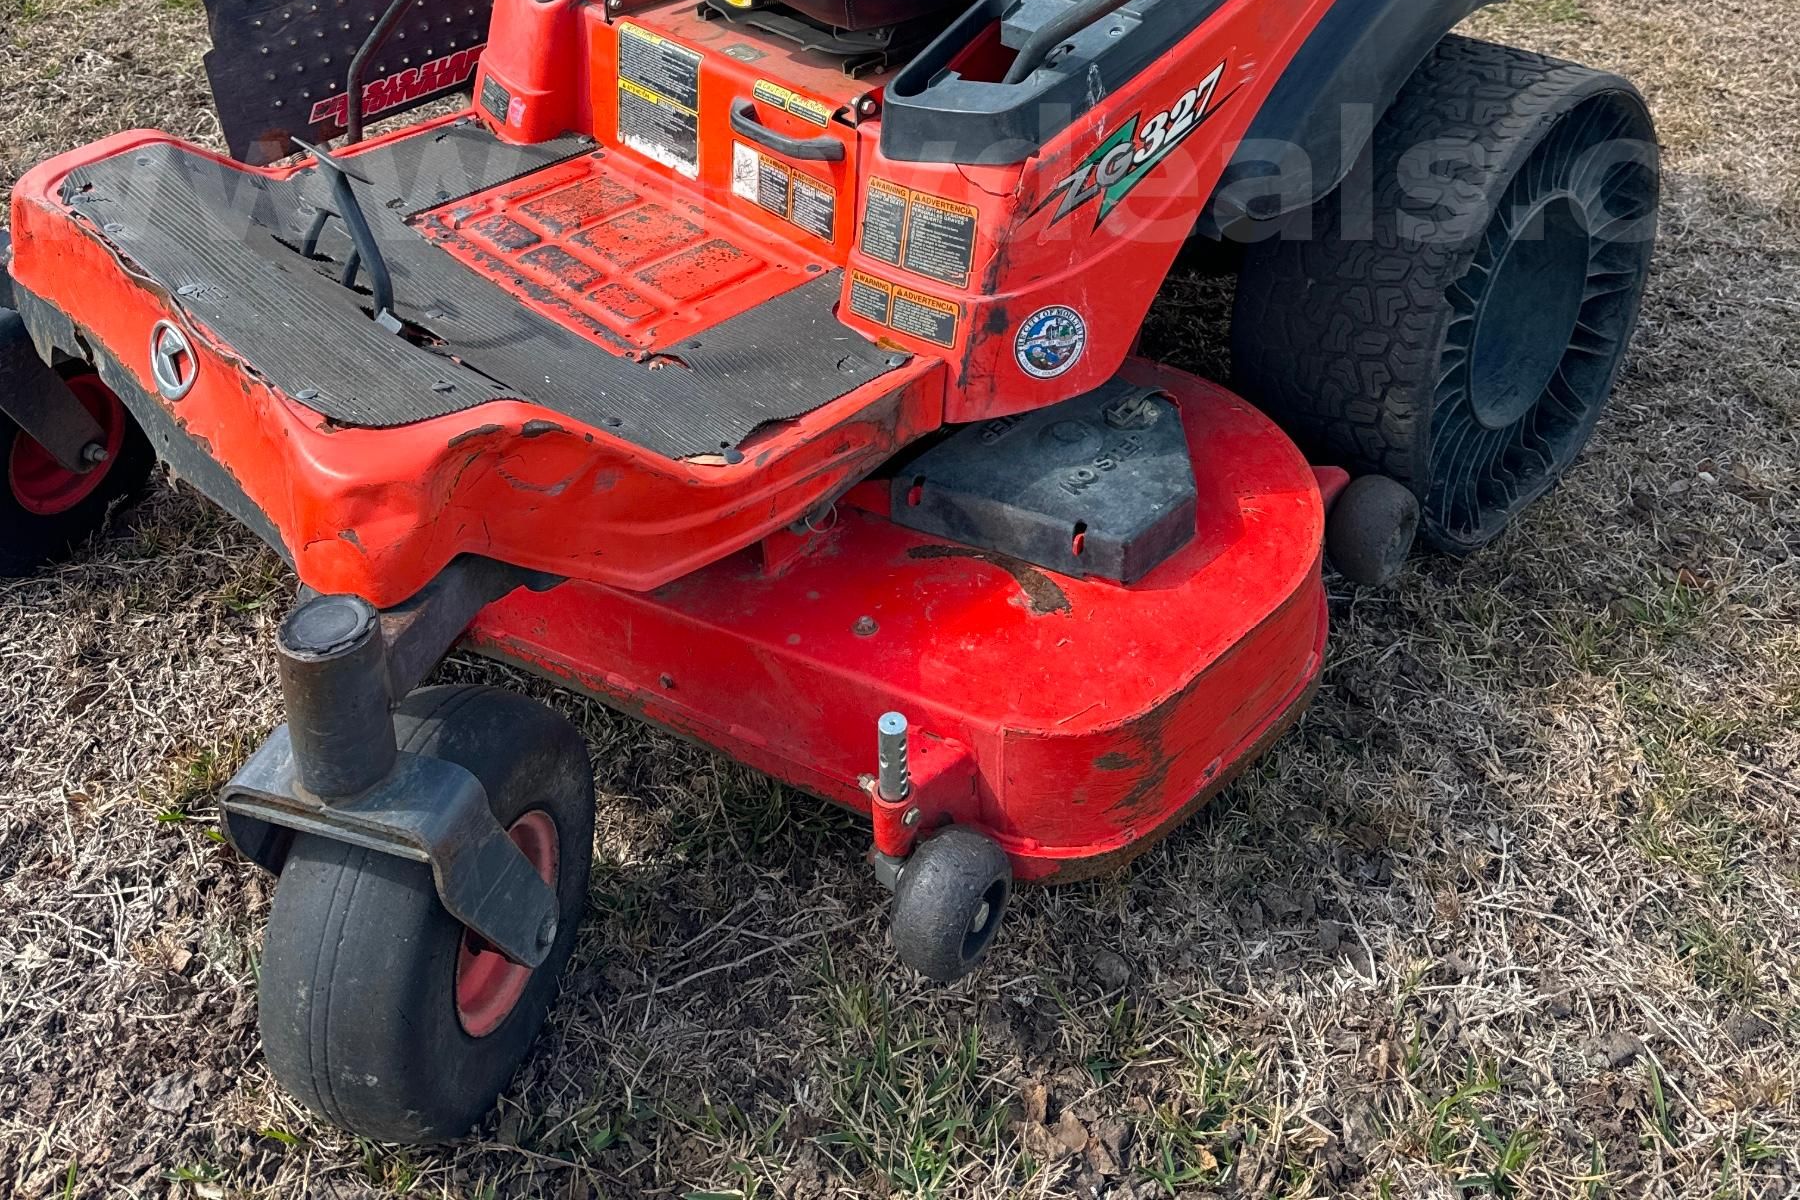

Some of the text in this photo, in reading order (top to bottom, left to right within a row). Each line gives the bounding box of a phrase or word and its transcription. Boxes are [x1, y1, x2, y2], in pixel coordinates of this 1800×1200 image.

[1048, 59, 1227, 229] ZG327
[877, 182, 906, 196] WARNING
[921, 196, 973, 216] ADVERTENCIA
[860, 275, 888, 291] WARNING
[903, 290, 954, 312] ADVERTENCIA
[1023, 314, 1041, 333] CITY
[1043, 309, 1053, 317] OF
